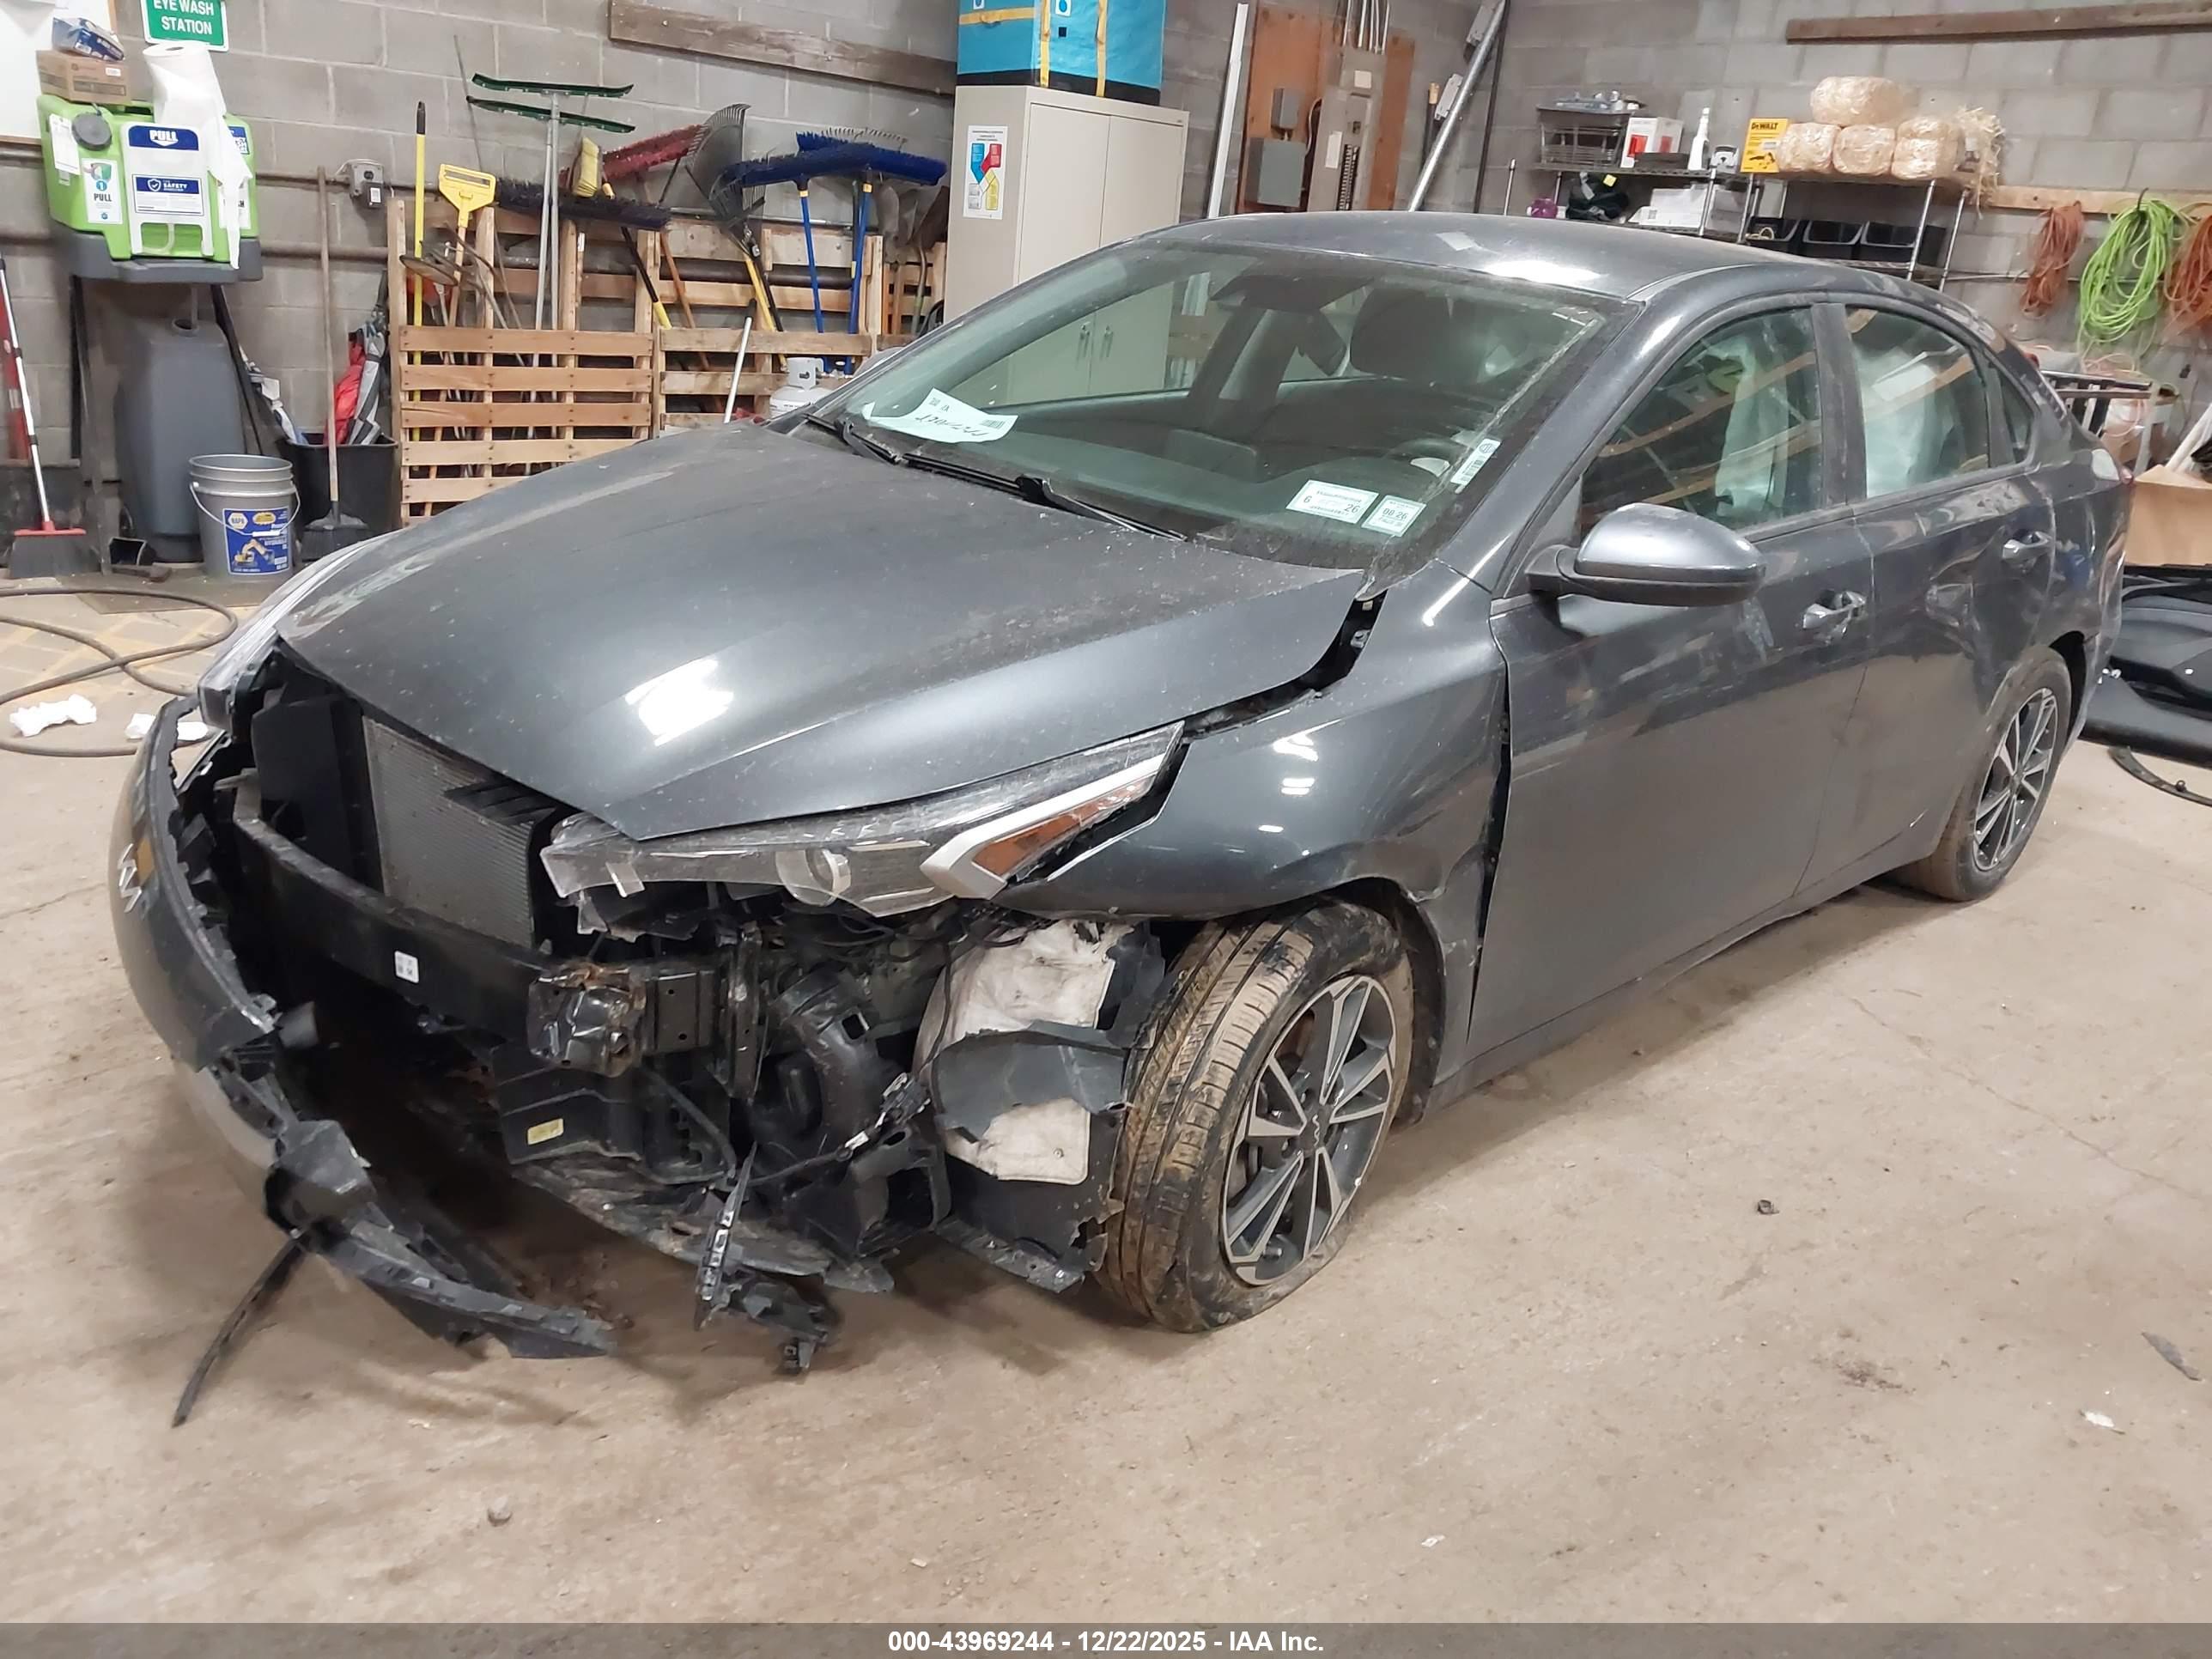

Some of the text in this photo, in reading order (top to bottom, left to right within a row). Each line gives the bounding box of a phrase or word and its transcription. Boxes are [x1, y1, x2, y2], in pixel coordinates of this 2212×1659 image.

[154, 0, 215, 15] EYE WASH
[161, 15, 213, 35] STATION
[149, 130, 179, 142] PULL
[94, 193, 112, 202] PULL
[1344, 503, 1361, 514] 26
